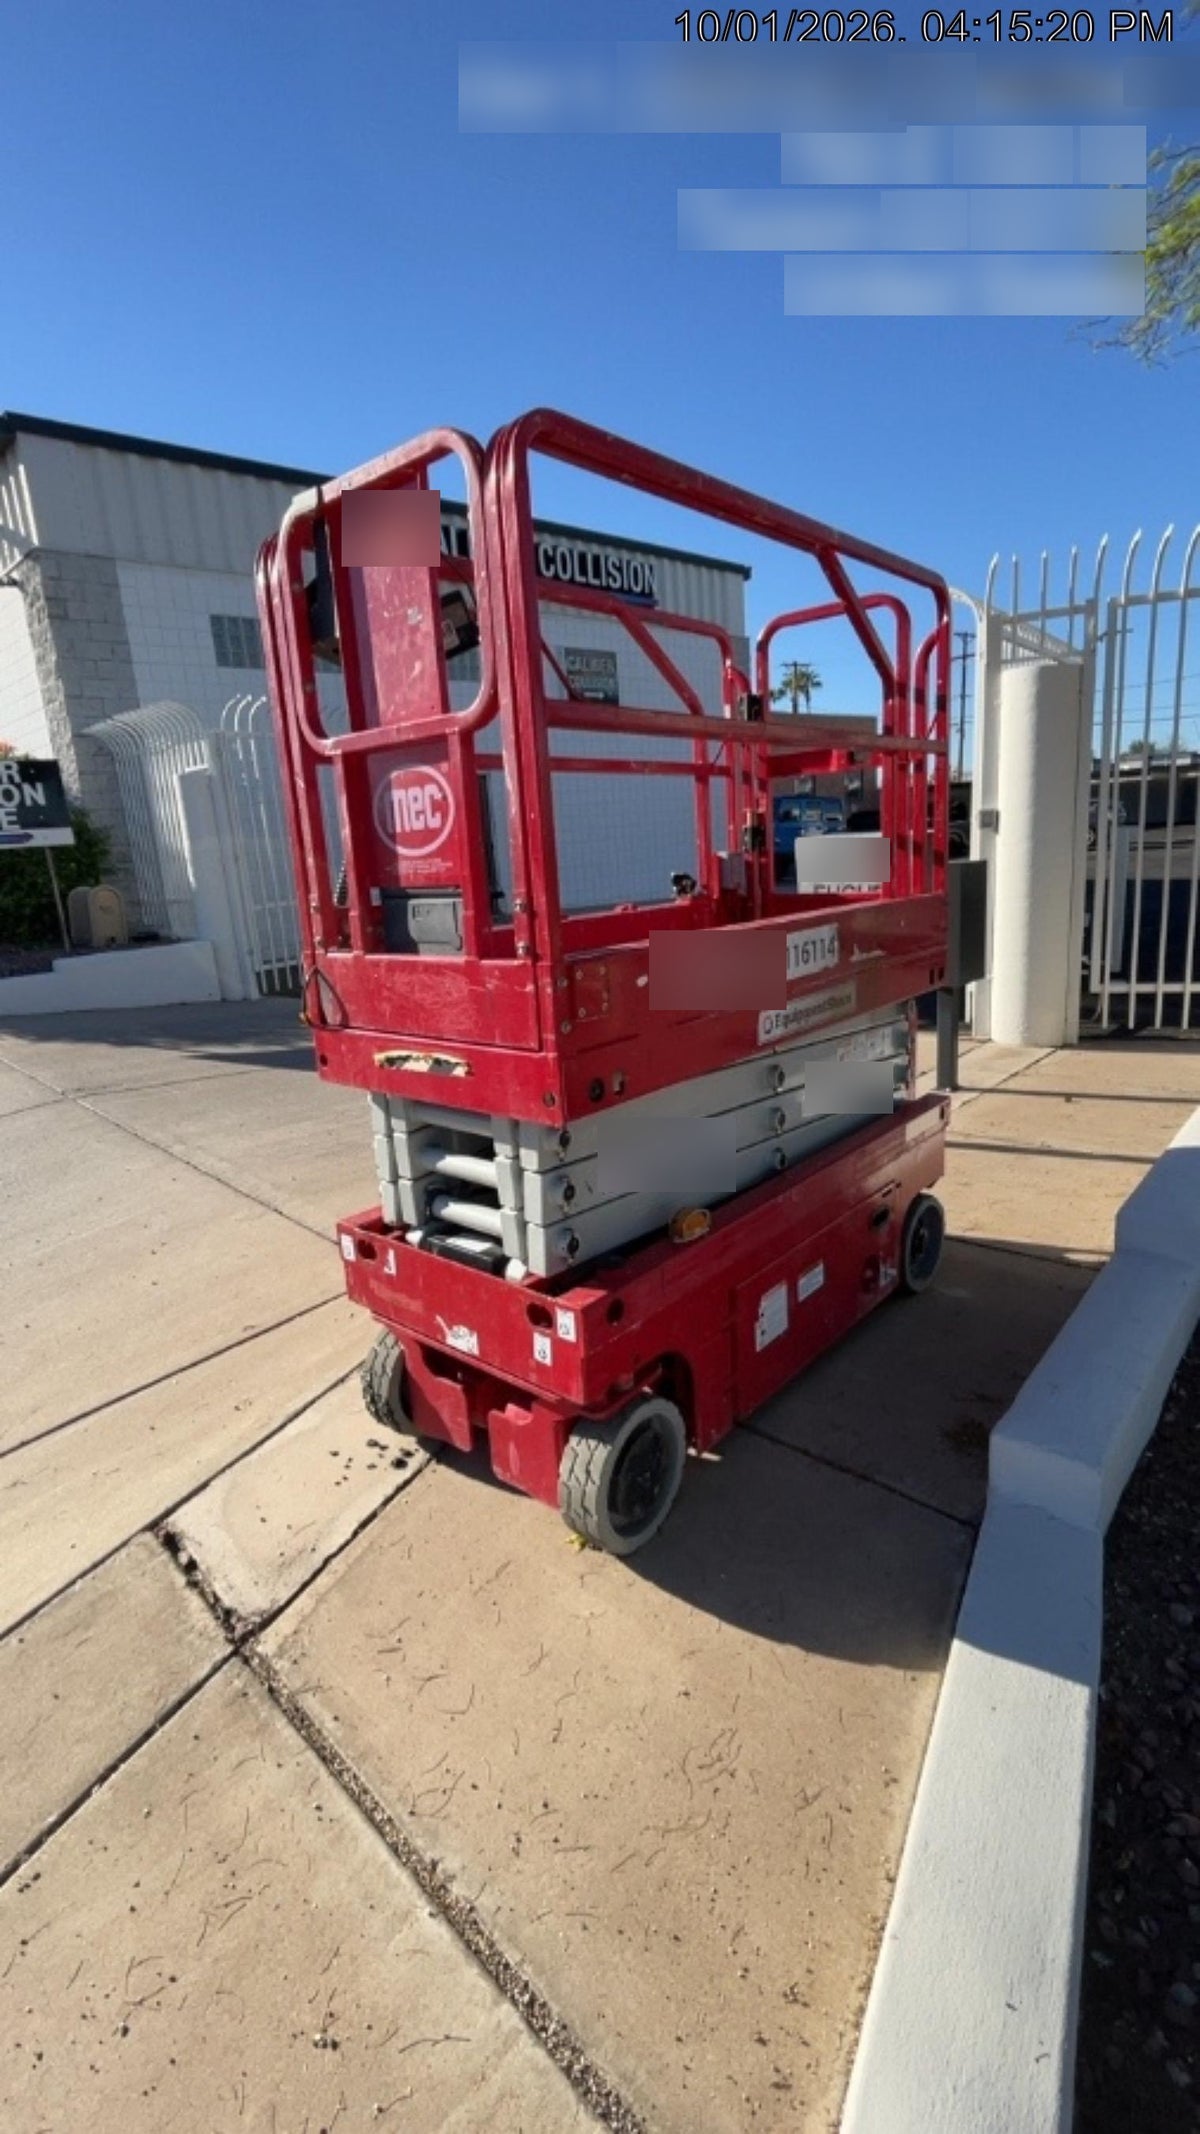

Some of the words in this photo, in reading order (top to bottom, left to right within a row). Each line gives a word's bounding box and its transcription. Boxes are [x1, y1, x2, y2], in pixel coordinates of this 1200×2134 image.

[538, 543, 657, 594] COLLISION
[0, 761, 21, 783] R
[0, 782, 46, 808] ON
